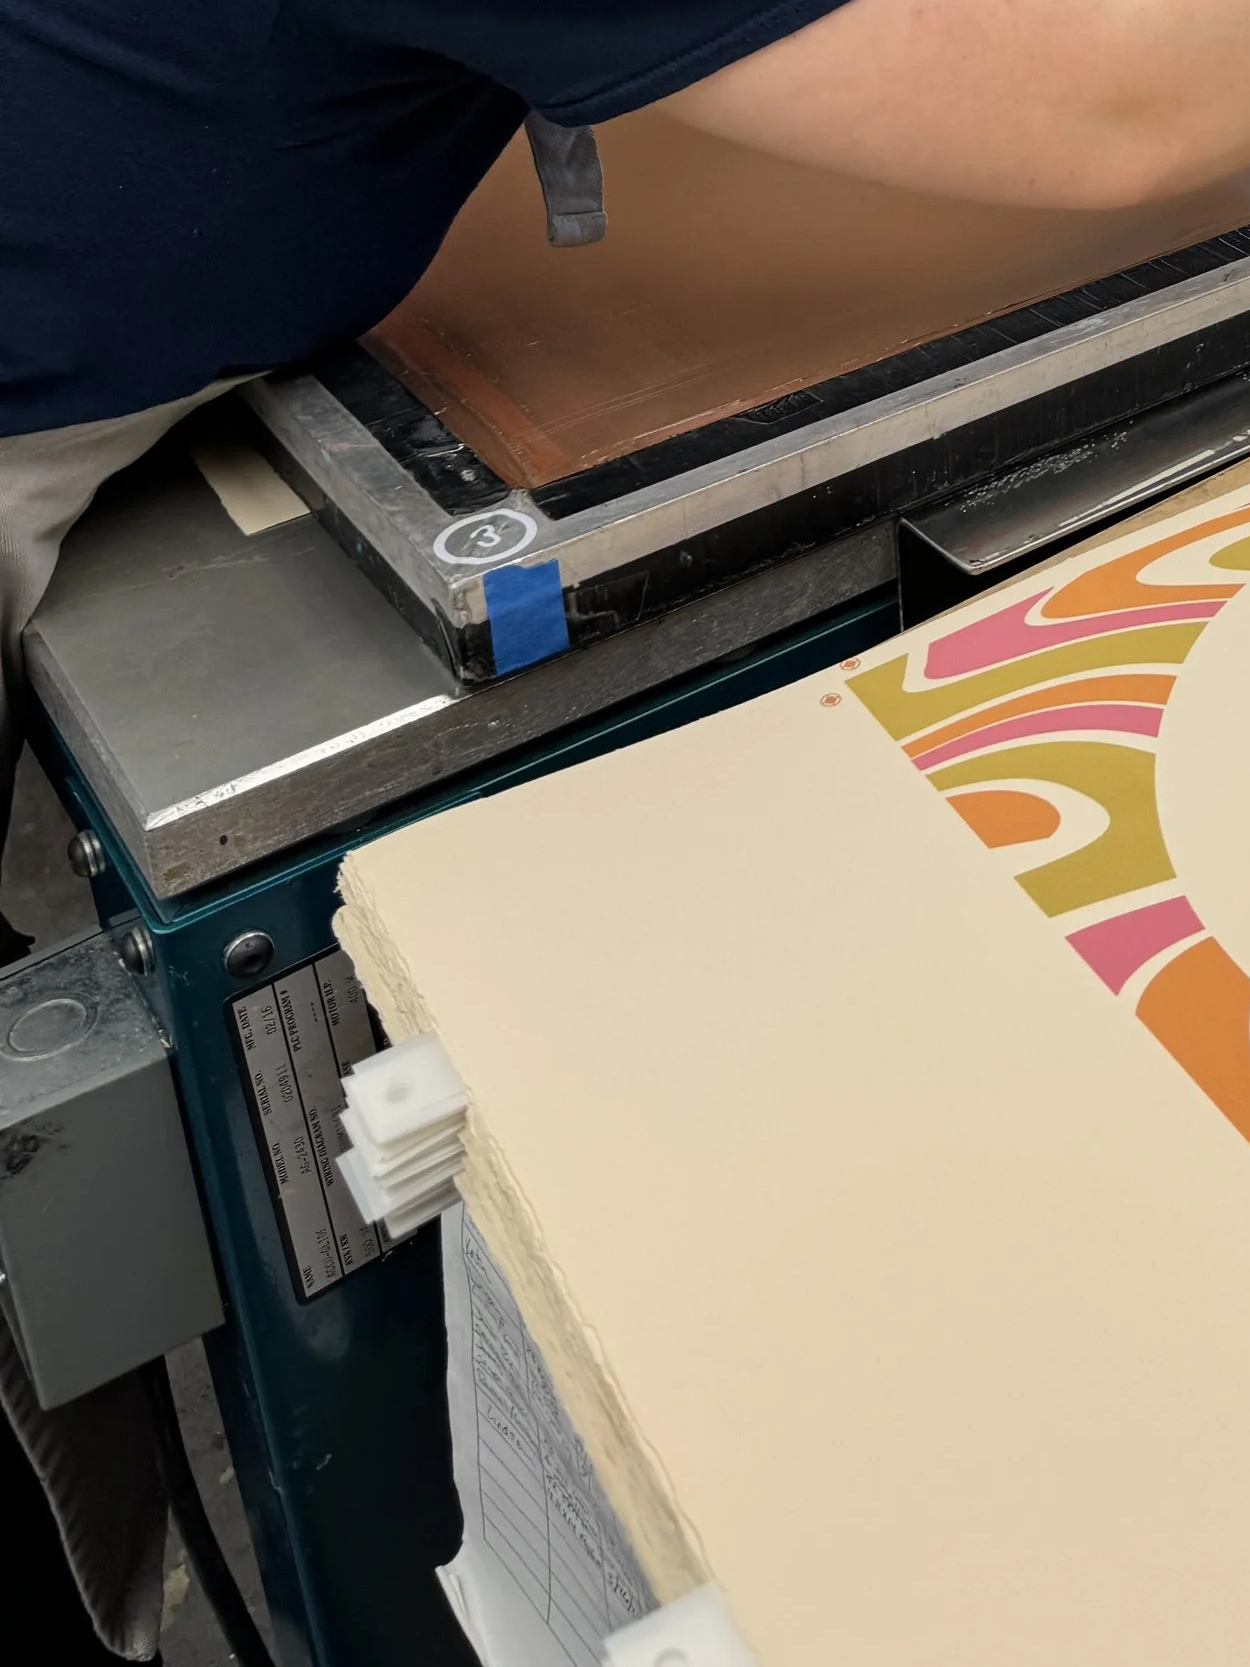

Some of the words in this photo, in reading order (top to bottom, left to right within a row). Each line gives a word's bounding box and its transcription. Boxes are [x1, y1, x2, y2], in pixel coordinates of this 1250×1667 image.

[470, 524, 501, 548] 3
[238, 1006, 249, 1029] DATE
[262, 1005, 276, 1034] 02/16
[282, 995, 297, 1034] PROGRAM
[259, 1086, 271, 1114] SERIAL
[313, 1121, 326, 1156] DIAGRAM
[276, 1155, 288, 1183] MODEL
[294, 1136, 311, 1175] AG-2430
[303, 1265, 314, 1287] NAME
